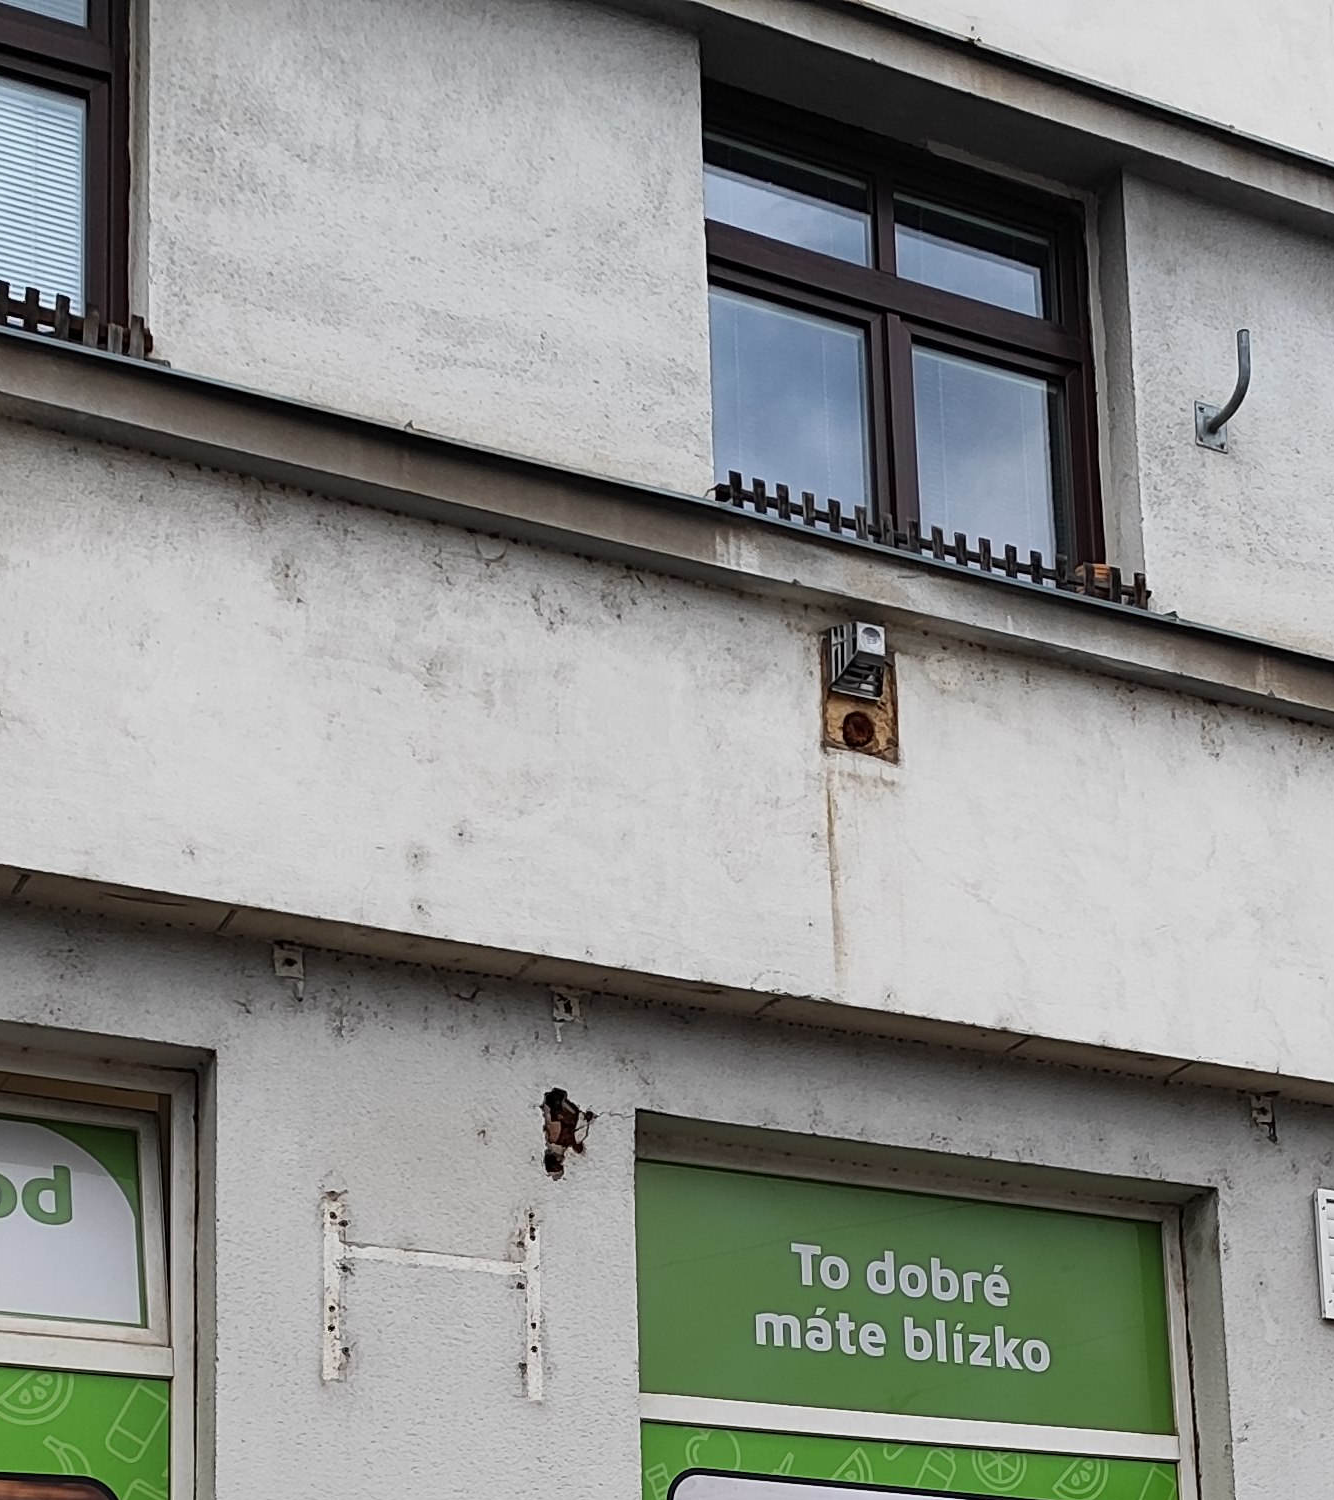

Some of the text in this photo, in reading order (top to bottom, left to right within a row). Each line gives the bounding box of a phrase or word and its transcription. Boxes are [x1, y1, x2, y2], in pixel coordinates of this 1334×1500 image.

[790, 1242, 1010, 1307] To dobré
[755, 1307, 1051, 1373] máte blízko
